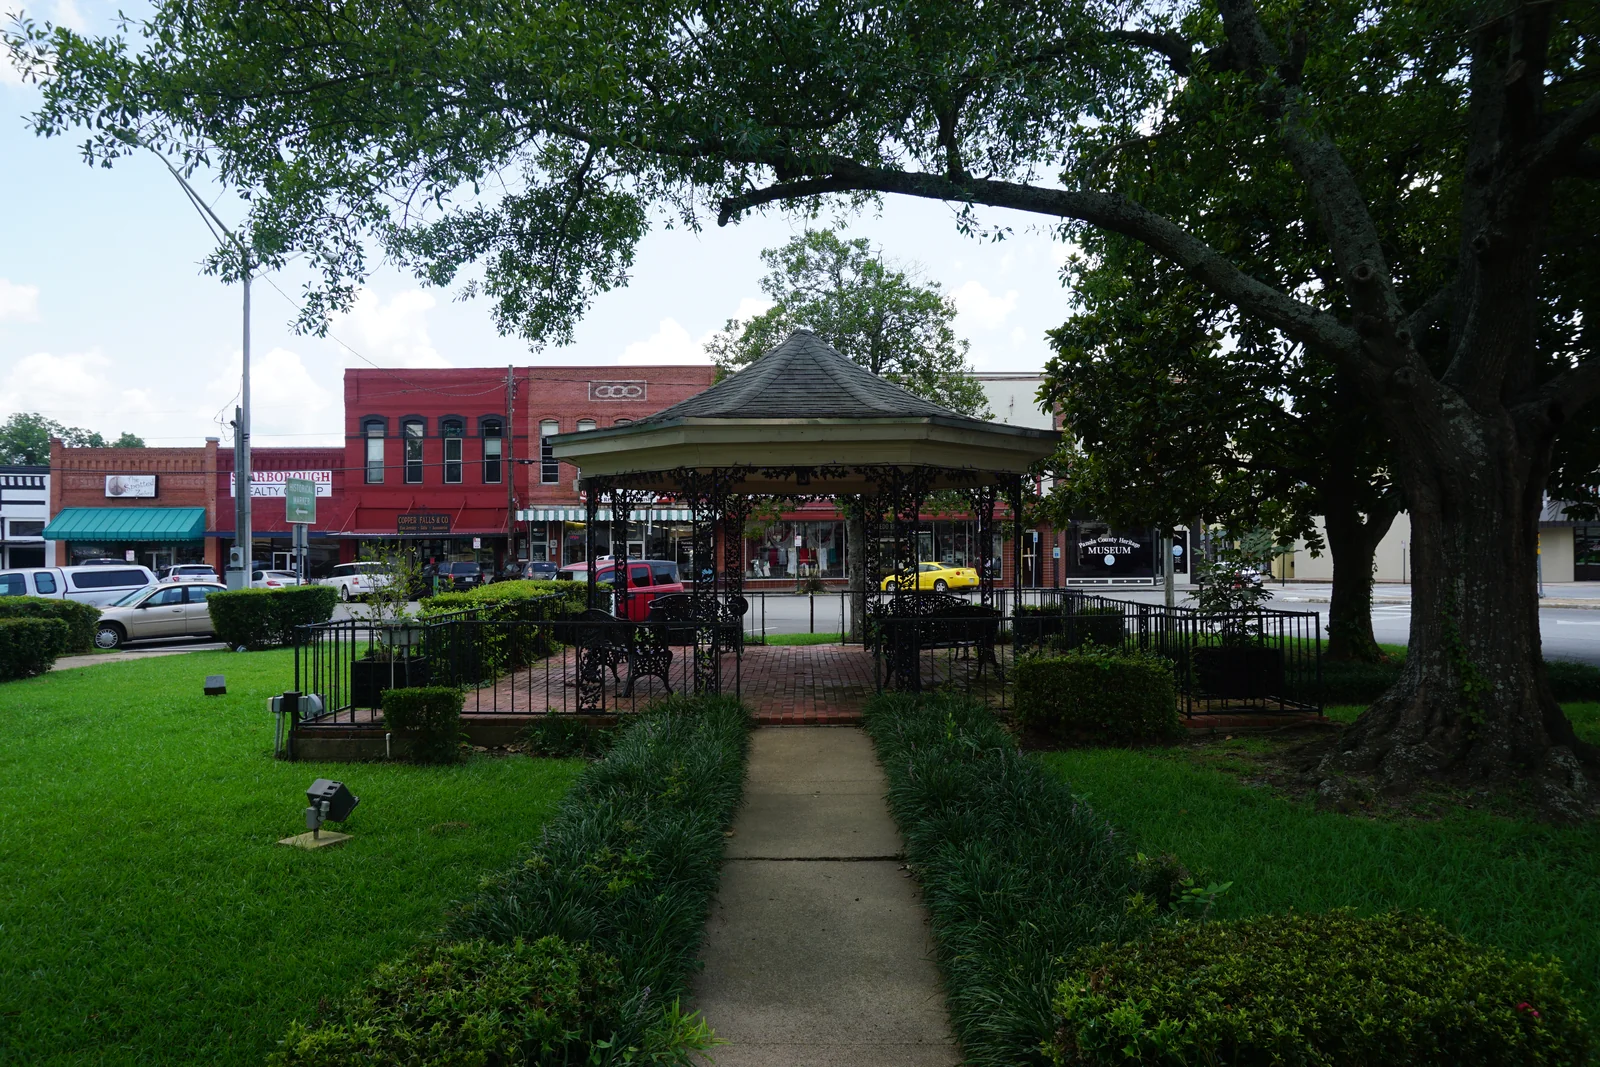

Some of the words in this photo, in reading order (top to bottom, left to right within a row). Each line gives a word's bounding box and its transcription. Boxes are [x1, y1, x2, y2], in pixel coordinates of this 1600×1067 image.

[250, 487, 280, 496] EALTY
[289, 483, 314, 494] HISTORICAL
[293, 496, 311, 506] MARKER
[398, 516, 417, 524] COPPER
[420, 516, 435, 524] FALLS
[441, 516, 449, 524] CO
[1078, 538, 1097, 548] Panola
[1119, 537, 1141, 548] Heritage
[1088, 546, 1131, 555] MUSEUM
